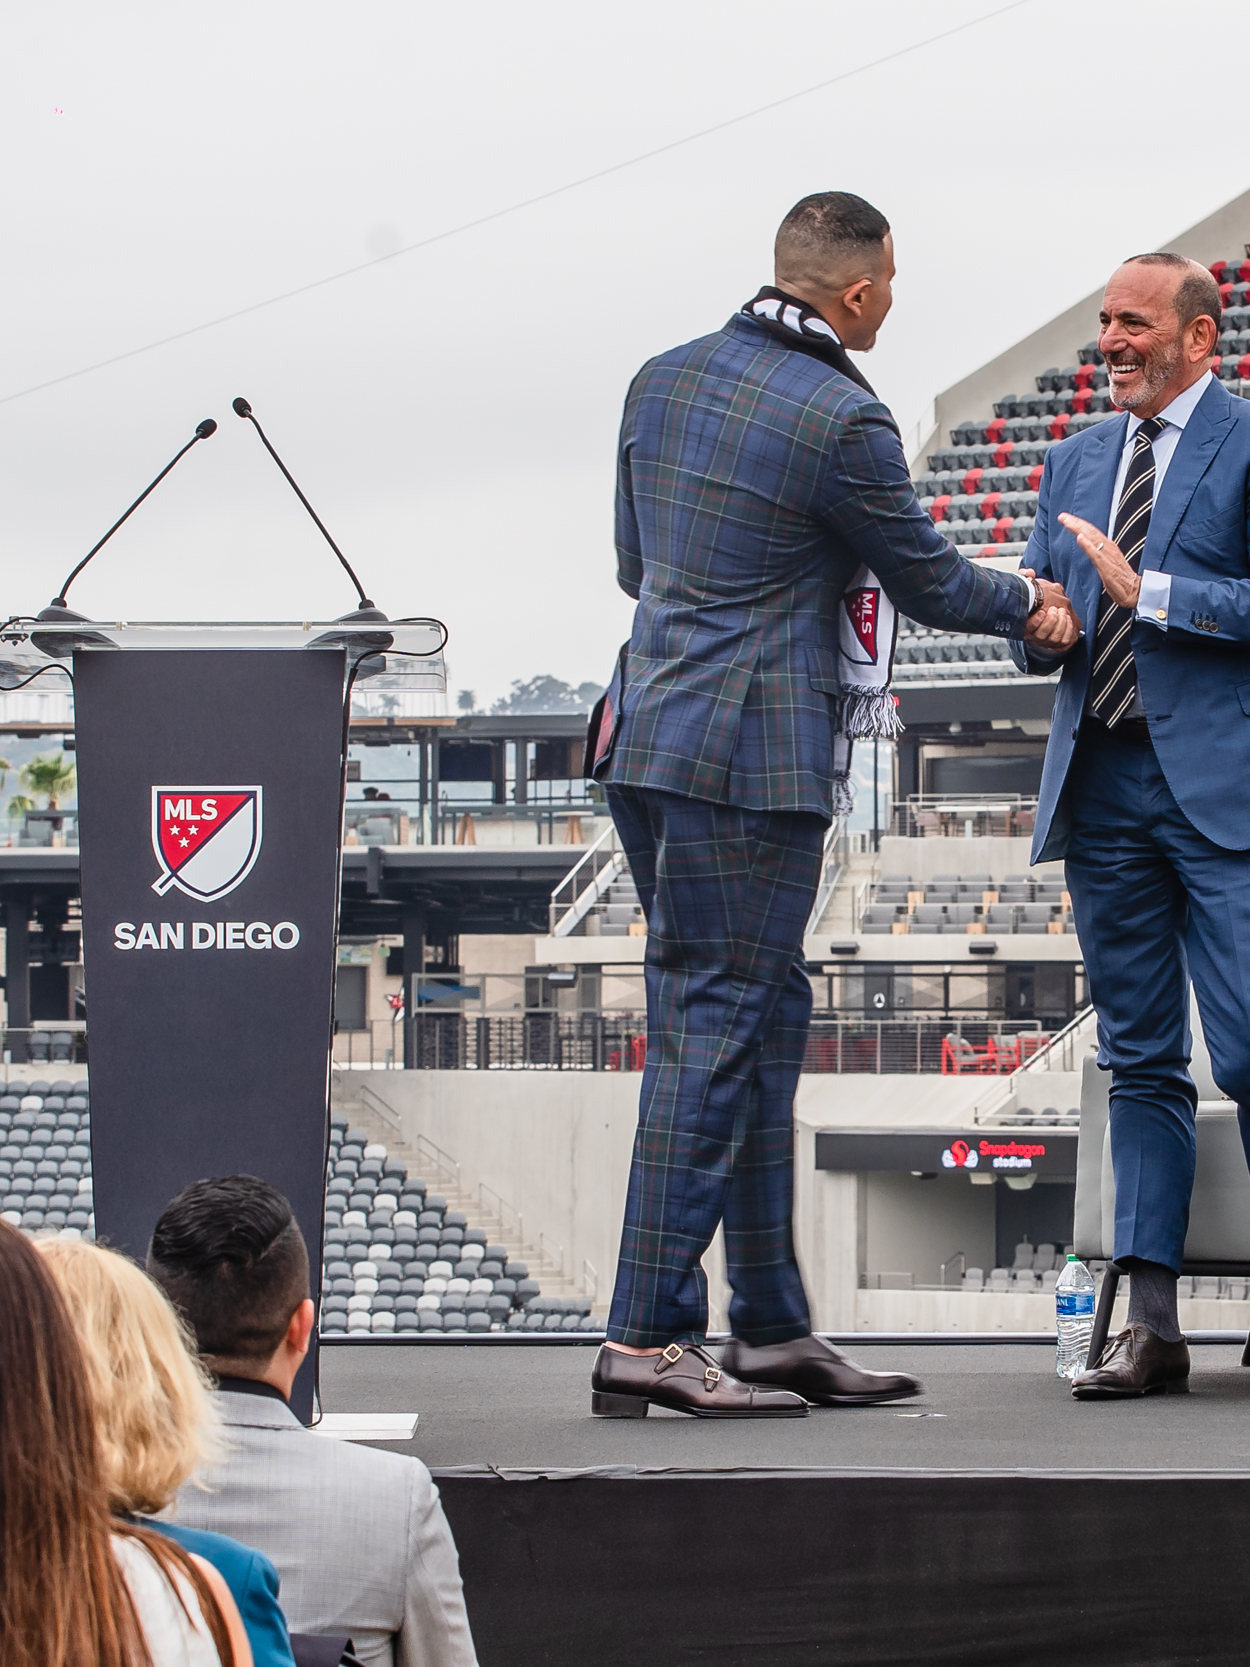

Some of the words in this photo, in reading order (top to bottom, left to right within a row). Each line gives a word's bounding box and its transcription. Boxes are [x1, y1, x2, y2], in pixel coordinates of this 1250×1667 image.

[861, 593, 874, 634] MLS
[164, 798, 218, 821] MLS
[113, 921, 184, 950] SAN
[192, 921, 301, 950] DIEGO
[979, 1140, 1046, 1158] Snapdragon
[992, 1155, 1032, 1168] stadium
